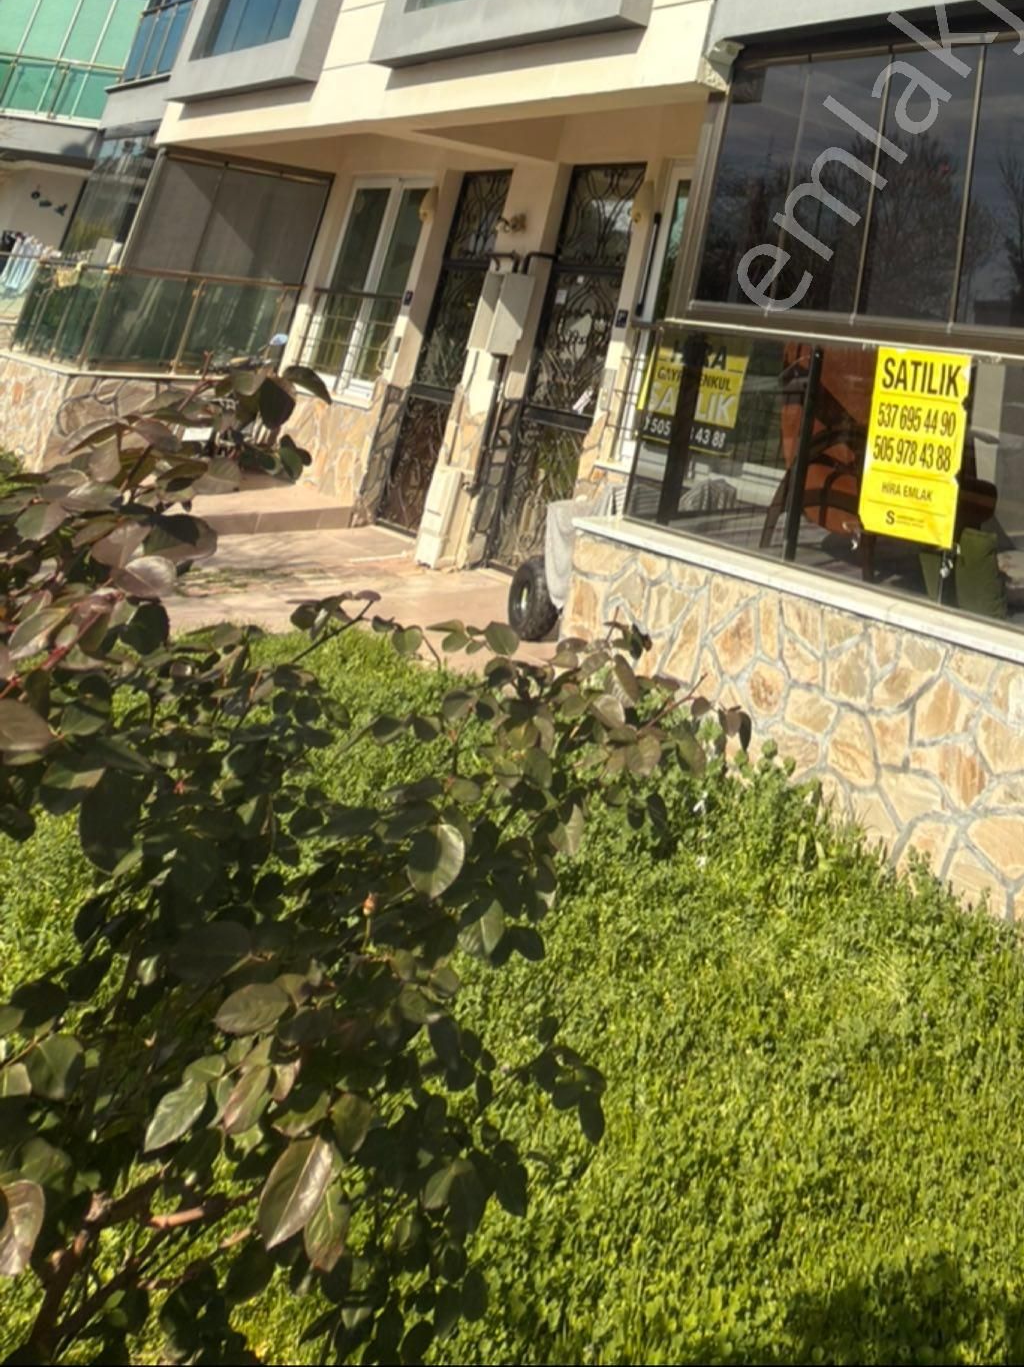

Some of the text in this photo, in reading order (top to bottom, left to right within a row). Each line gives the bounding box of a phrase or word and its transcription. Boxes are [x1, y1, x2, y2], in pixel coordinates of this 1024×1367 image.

[882, 357, 962, 397] SATILIK
[646, 381, 737, 430] SALIK
[877, 402, 957, 438] 537 695 44 90
[873, 435, 952, 472] 505 978 43 88
[903, 485, 933, 502] EMLAK
